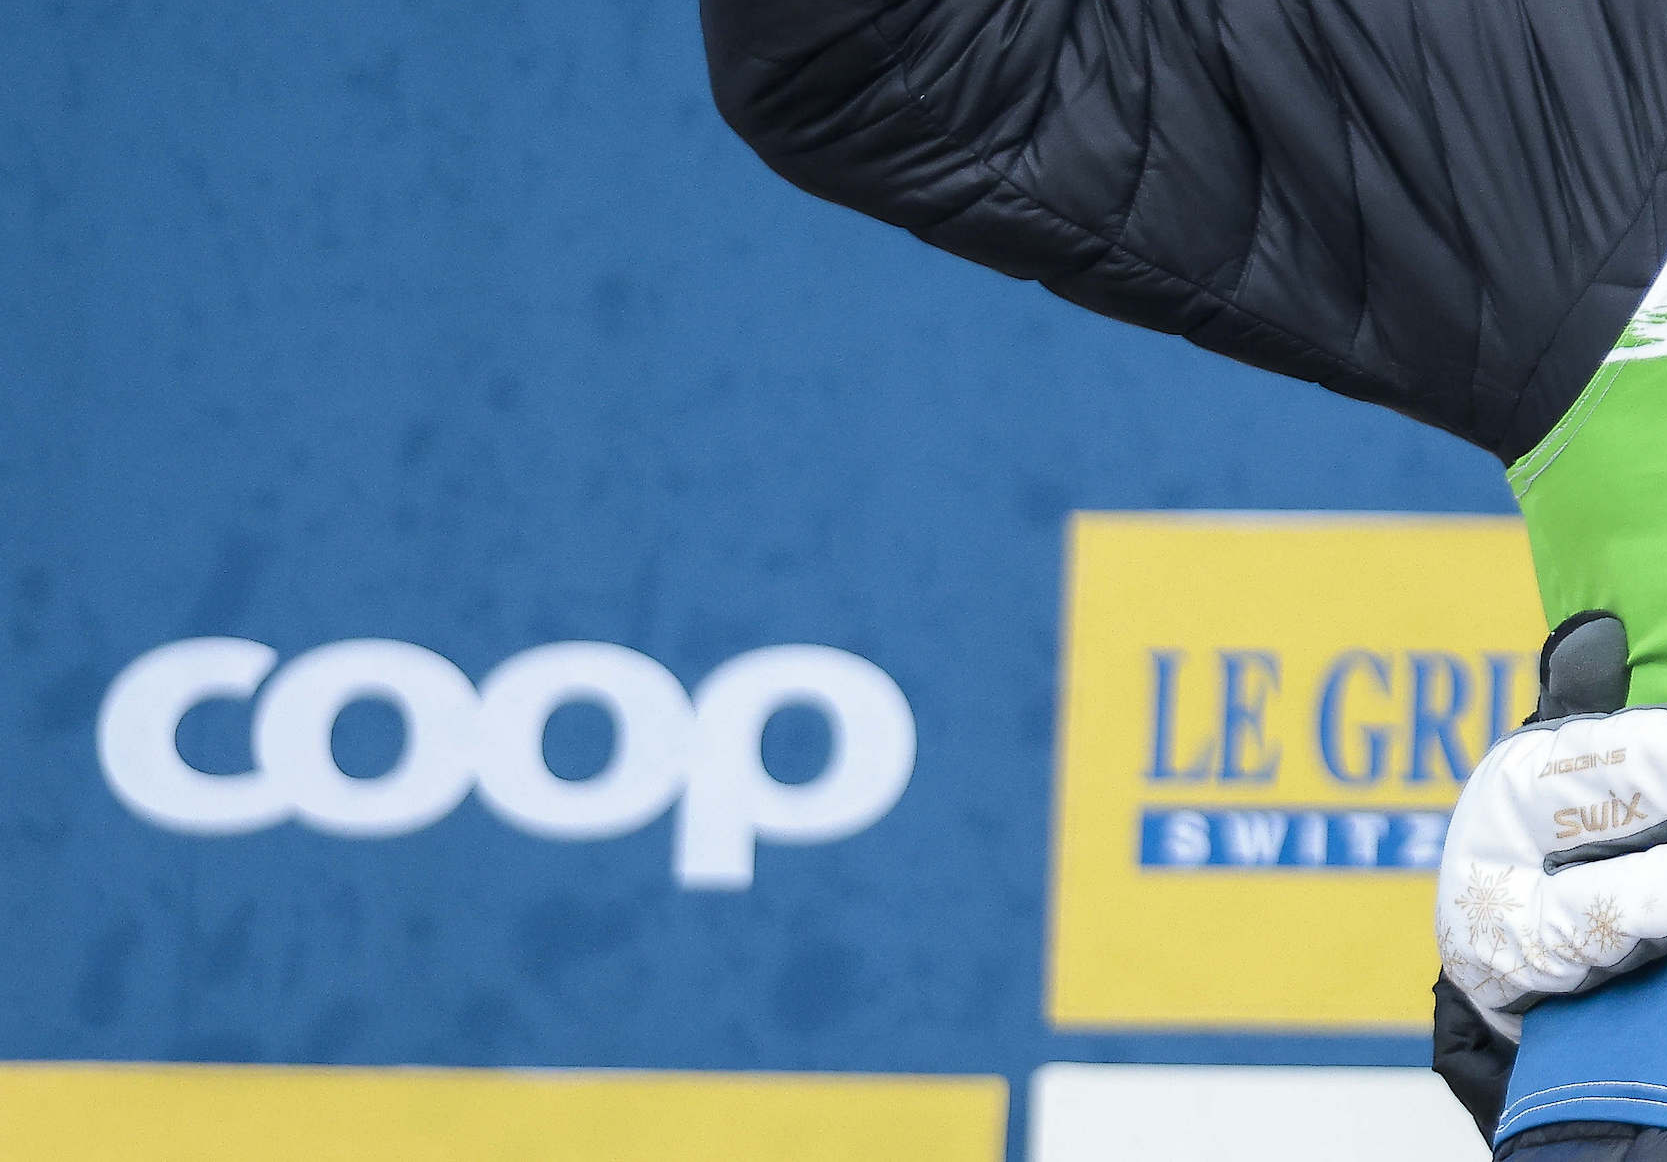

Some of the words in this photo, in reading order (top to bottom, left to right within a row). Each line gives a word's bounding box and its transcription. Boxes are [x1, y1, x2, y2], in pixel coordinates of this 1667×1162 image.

[96, 635, 913, 891] coop
[1143, 649, 1282, 784] LE
[1538, 747, 1627, 778] DIGGINS
